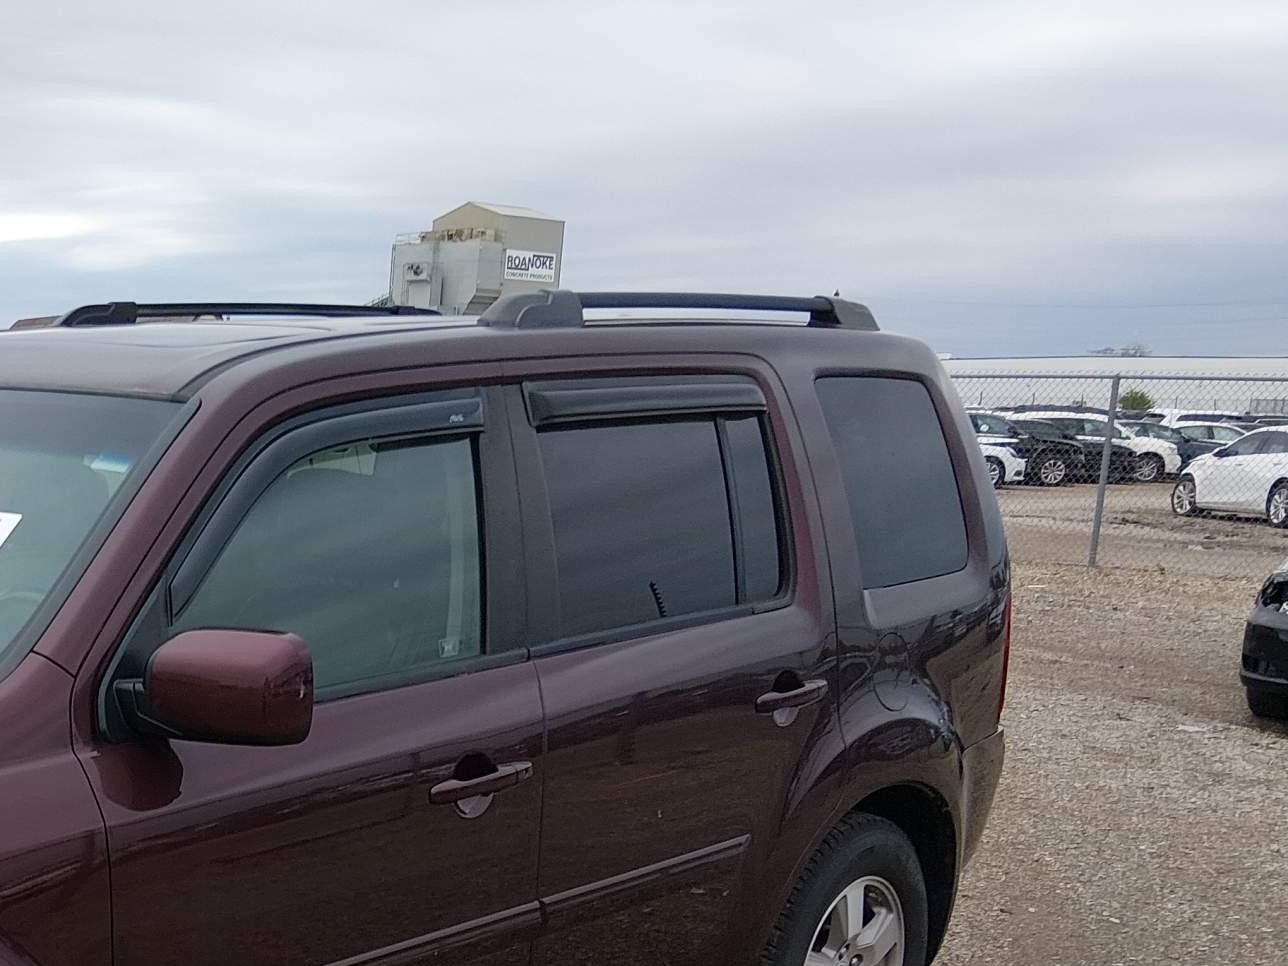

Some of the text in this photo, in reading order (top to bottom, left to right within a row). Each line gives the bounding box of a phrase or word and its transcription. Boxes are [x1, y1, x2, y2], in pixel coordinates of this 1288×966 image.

[506, 254, 554, 271] ROANOKE
[505, 271, 553, 281] CONCRETE PRODUCTS
